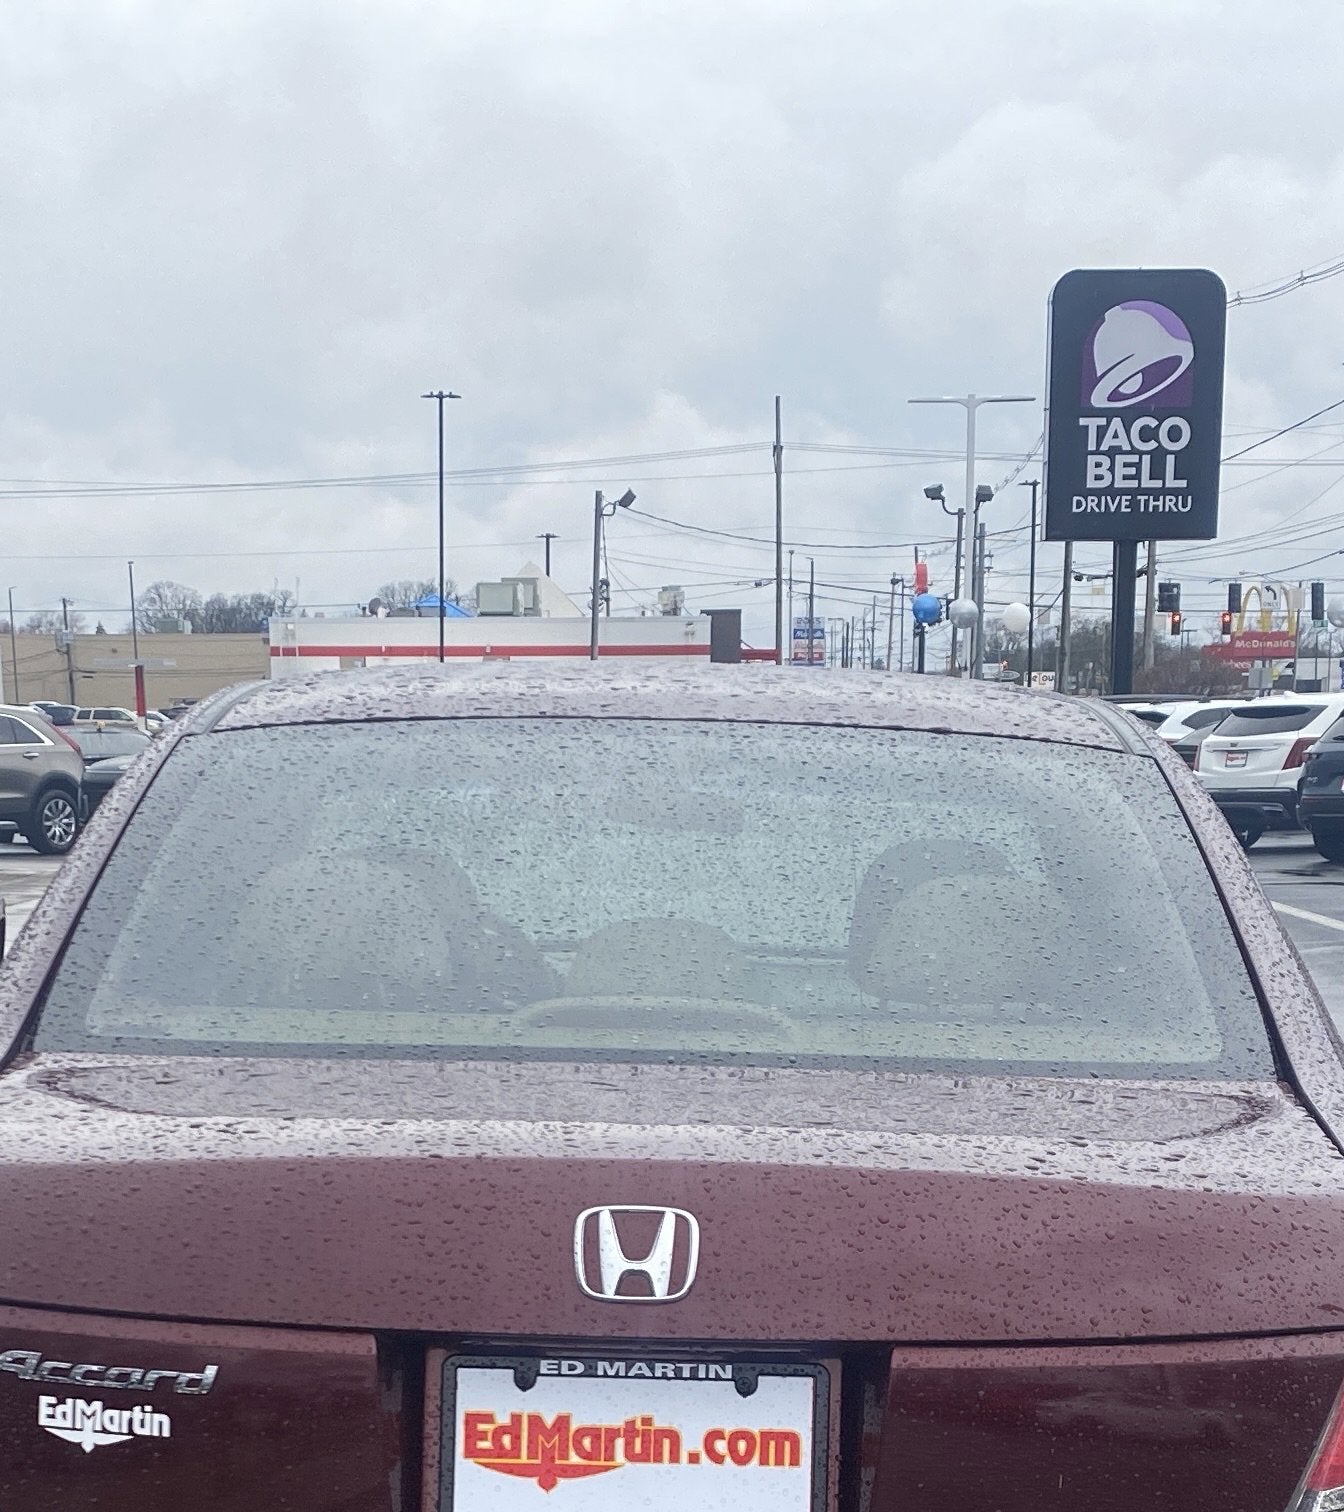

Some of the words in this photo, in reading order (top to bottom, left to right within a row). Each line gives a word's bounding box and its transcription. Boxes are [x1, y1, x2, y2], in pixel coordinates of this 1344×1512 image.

[1078, 416, 1191, 451] TACO
[1086, 454, 1187, 488] BELL
[1072, 496, 1132, 513] DRIVE
[1137, 495, 1192, 512] THRU
[539, 1360, 584, 1376] ED
[597, 1361, 734, 1380] MARTIN
[37, 1395, 171, 1438] EdMartin
[463, 1410, 802, 1468] EdMartin.com
